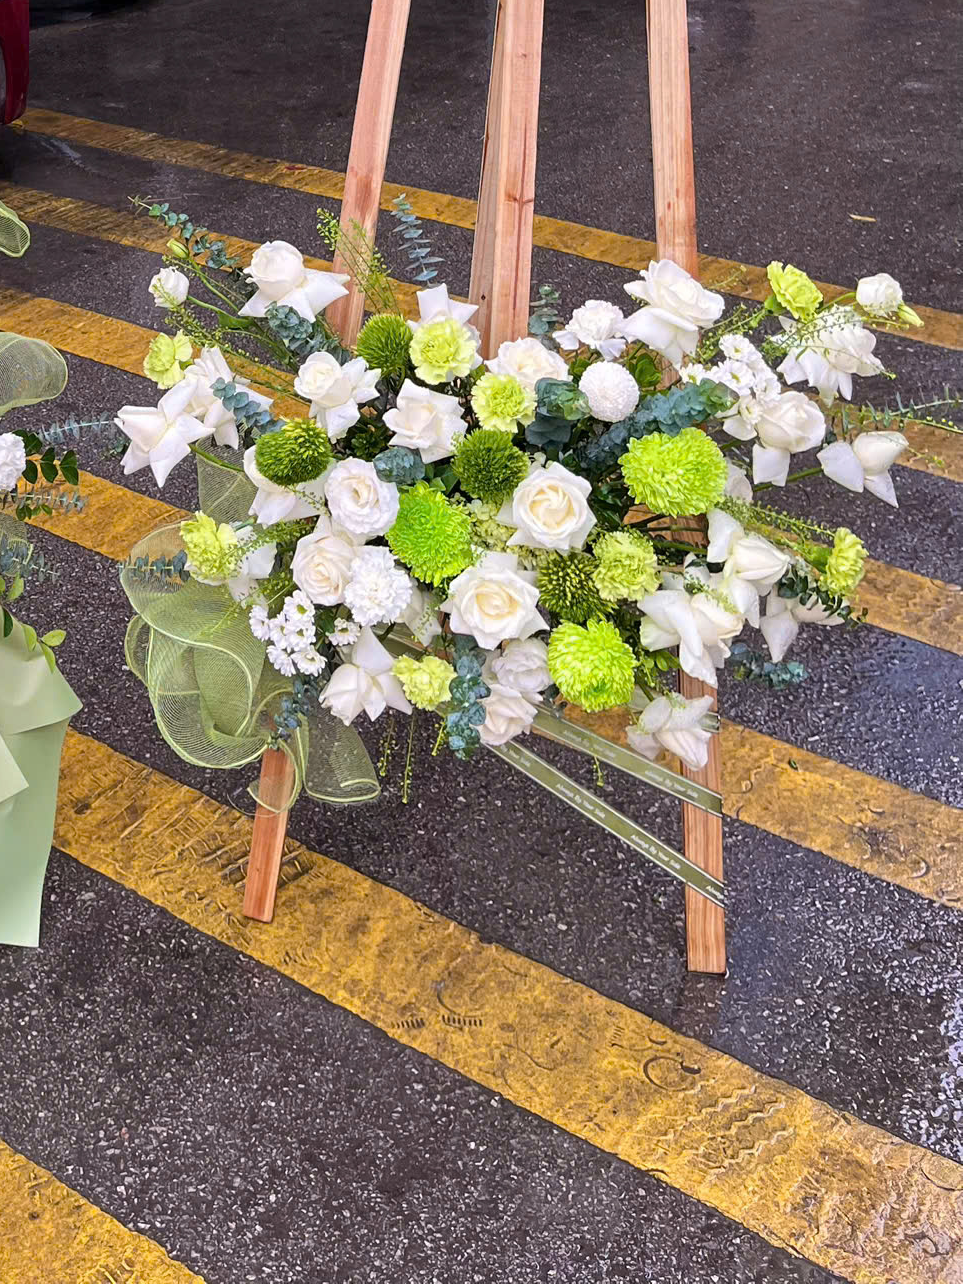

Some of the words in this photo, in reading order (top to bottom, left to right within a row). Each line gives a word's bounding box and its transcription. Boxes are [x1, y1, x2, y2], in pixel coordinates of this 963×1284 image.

[556, 784, 574, 798] Always
[574, 795, 582, 804] By
[582, 800, 594, 810] Your
[594, 808, 606, 819] Side
[630, 834, 649, 849] Always
[648, 845, 657, 854] By
[658, 851, 670, 861] Your
[670, 860, 681, 870] Side
